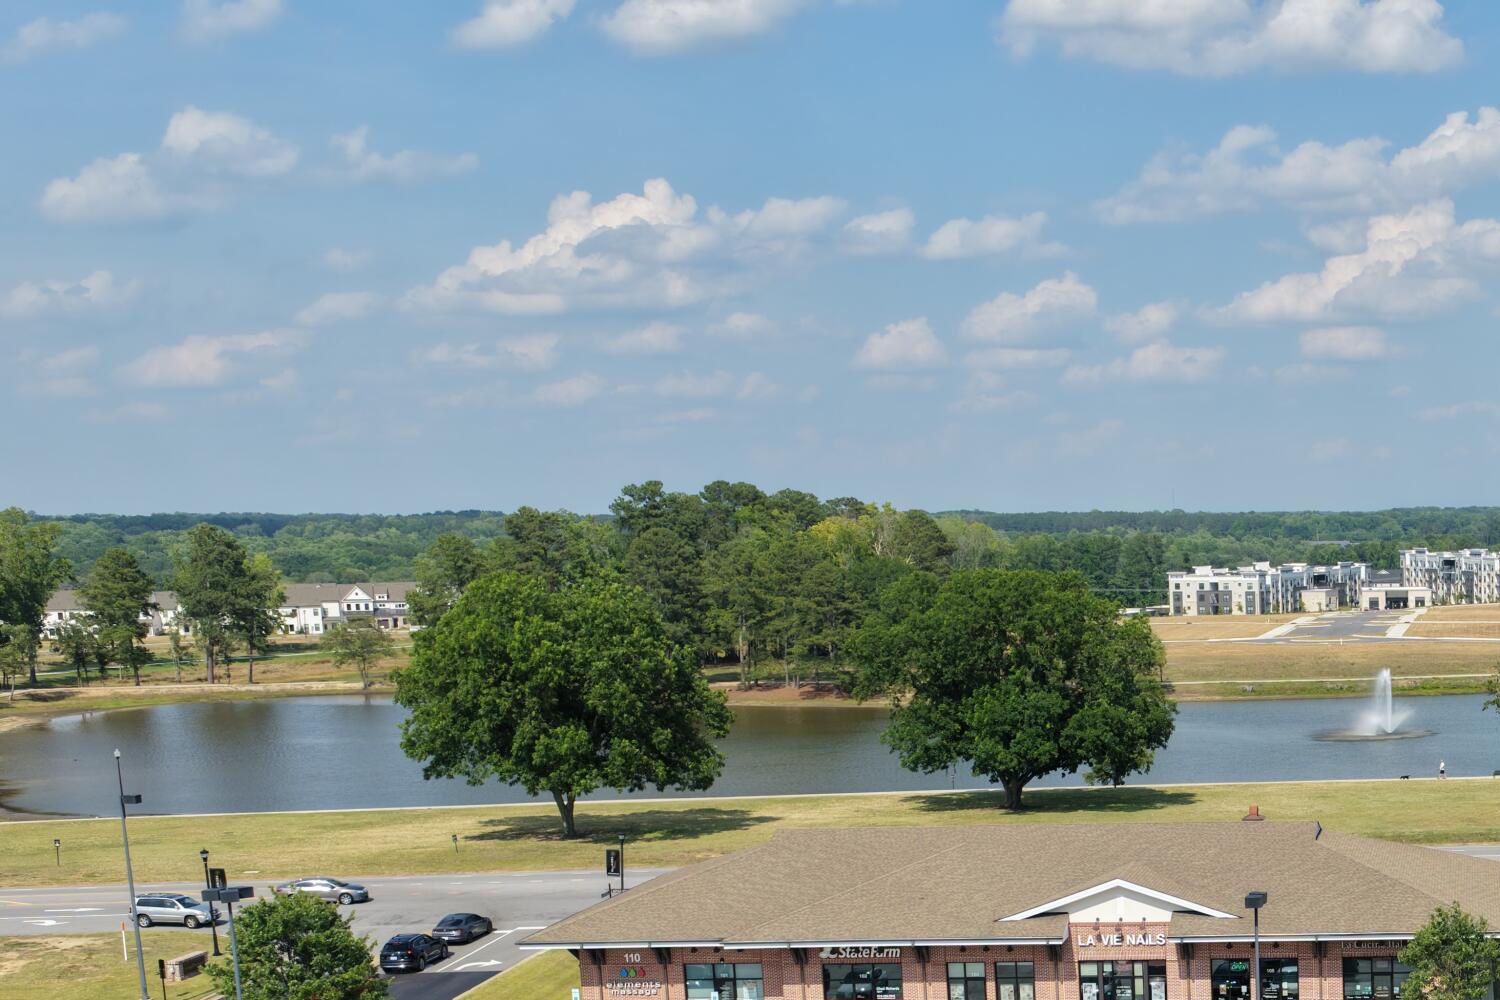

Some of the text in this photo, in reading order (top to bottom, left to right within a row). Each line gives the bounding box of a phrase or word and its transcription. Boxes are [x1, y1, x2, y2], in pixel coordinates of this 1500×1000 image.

[1077, 933, 1166, 947] LA VIE NAILS
[624, 953, 641, 963] 110
[606, 981, 661, 989] elements
[611, 987, 657, 996] massage
